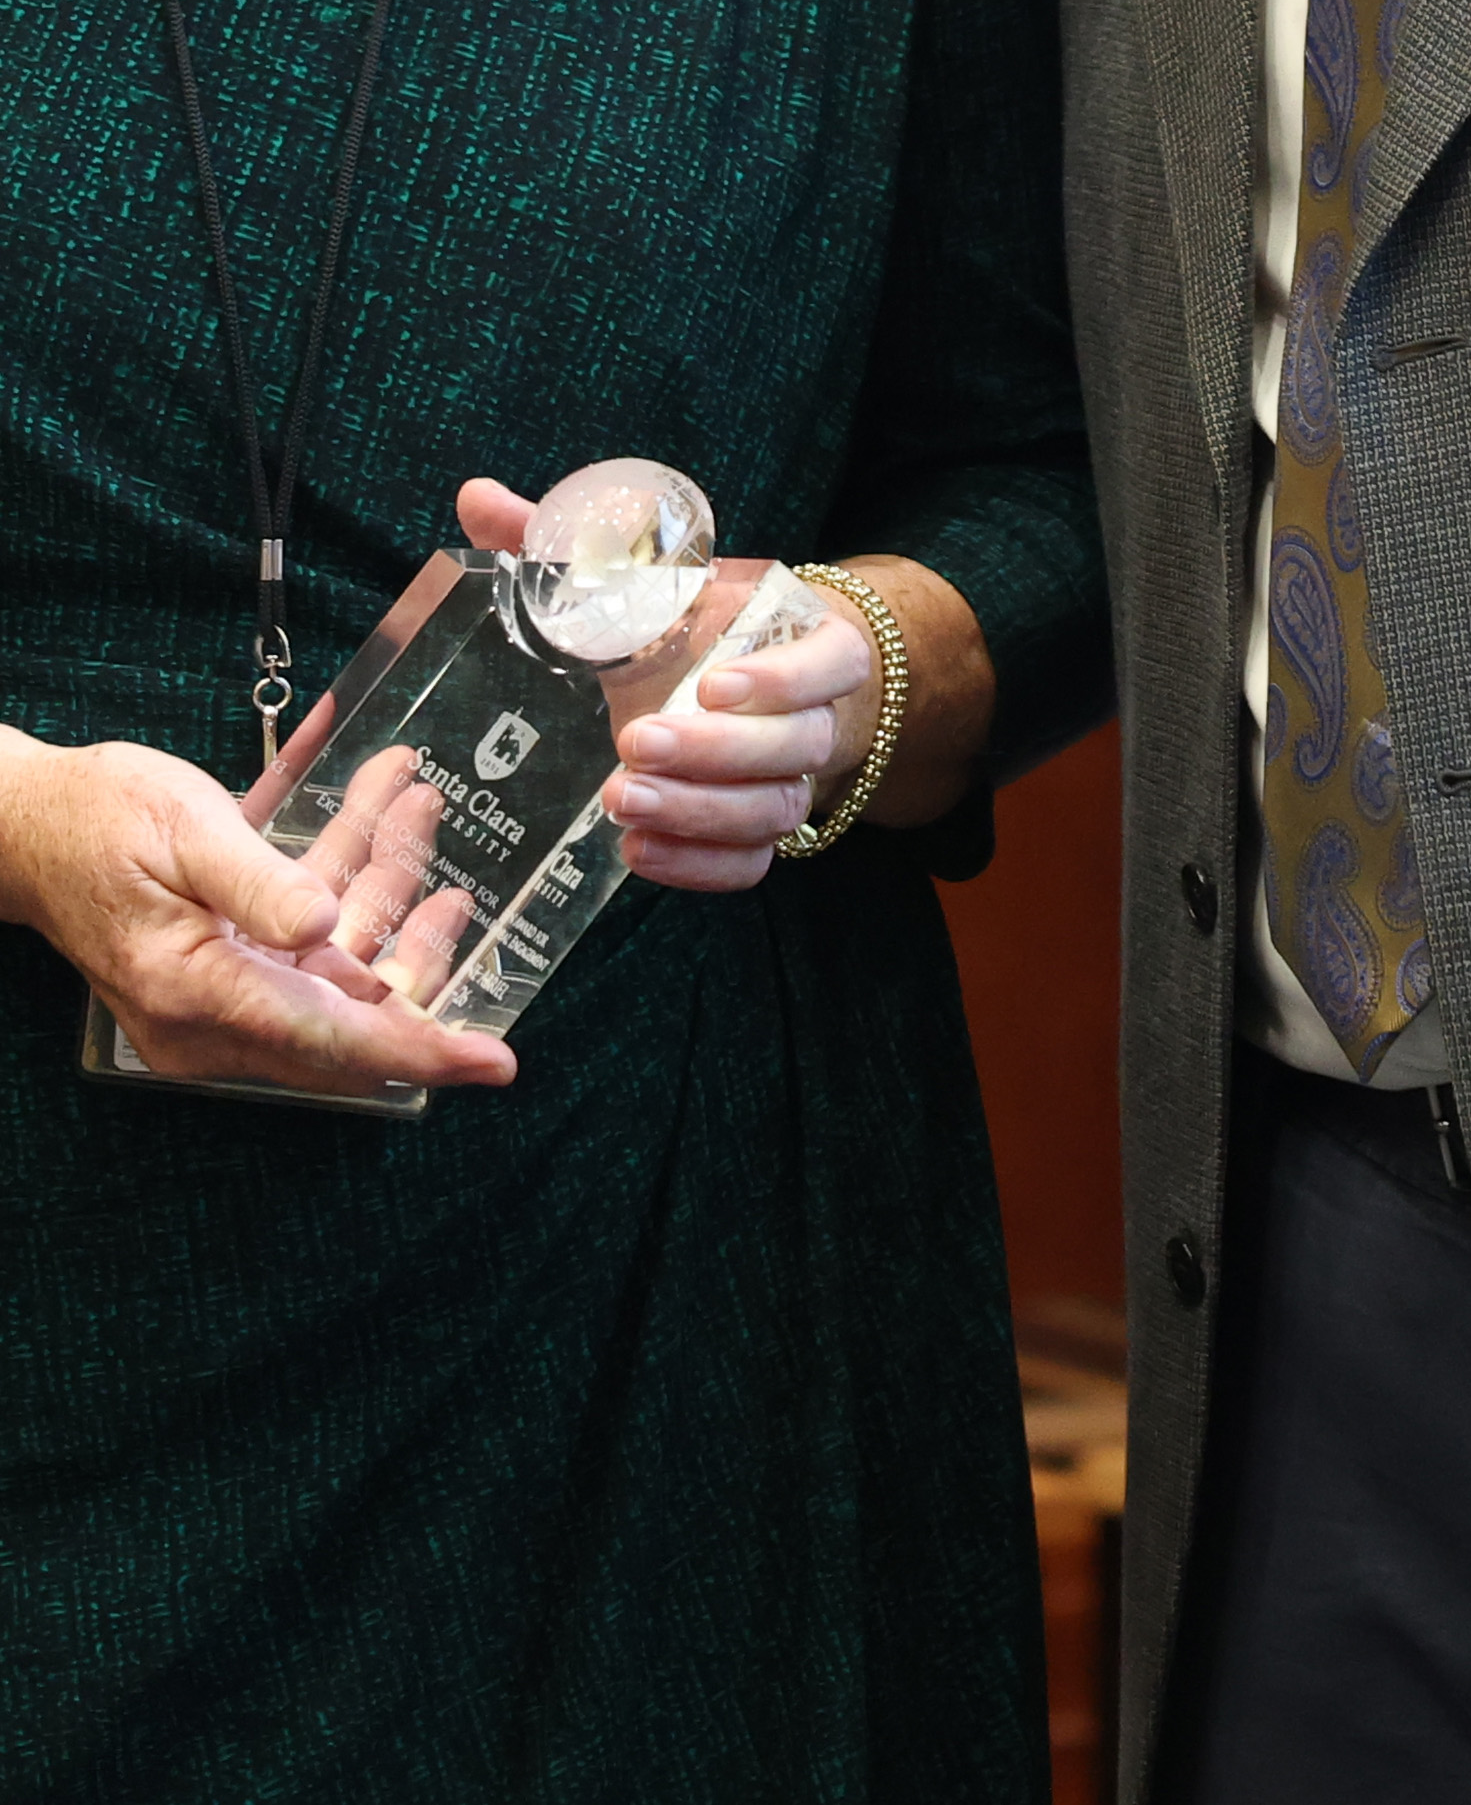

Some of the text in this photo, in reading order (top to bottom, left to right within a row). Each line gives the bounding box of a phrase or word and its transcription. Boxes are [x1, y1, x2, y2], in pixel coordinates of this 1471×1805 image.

[407, 746, 526, 845] Santa Clara
[311, 843, 458, 962] EVANGELINE ABRIEL
[395, 850, 438, 889] GLOBAL
[437, 880, 499, 931] ENGAGEME
[433, 855, 477, 891] AWARD
[474, 885, 500, 910] FOR
[549, 850, 585, 891] Clara
